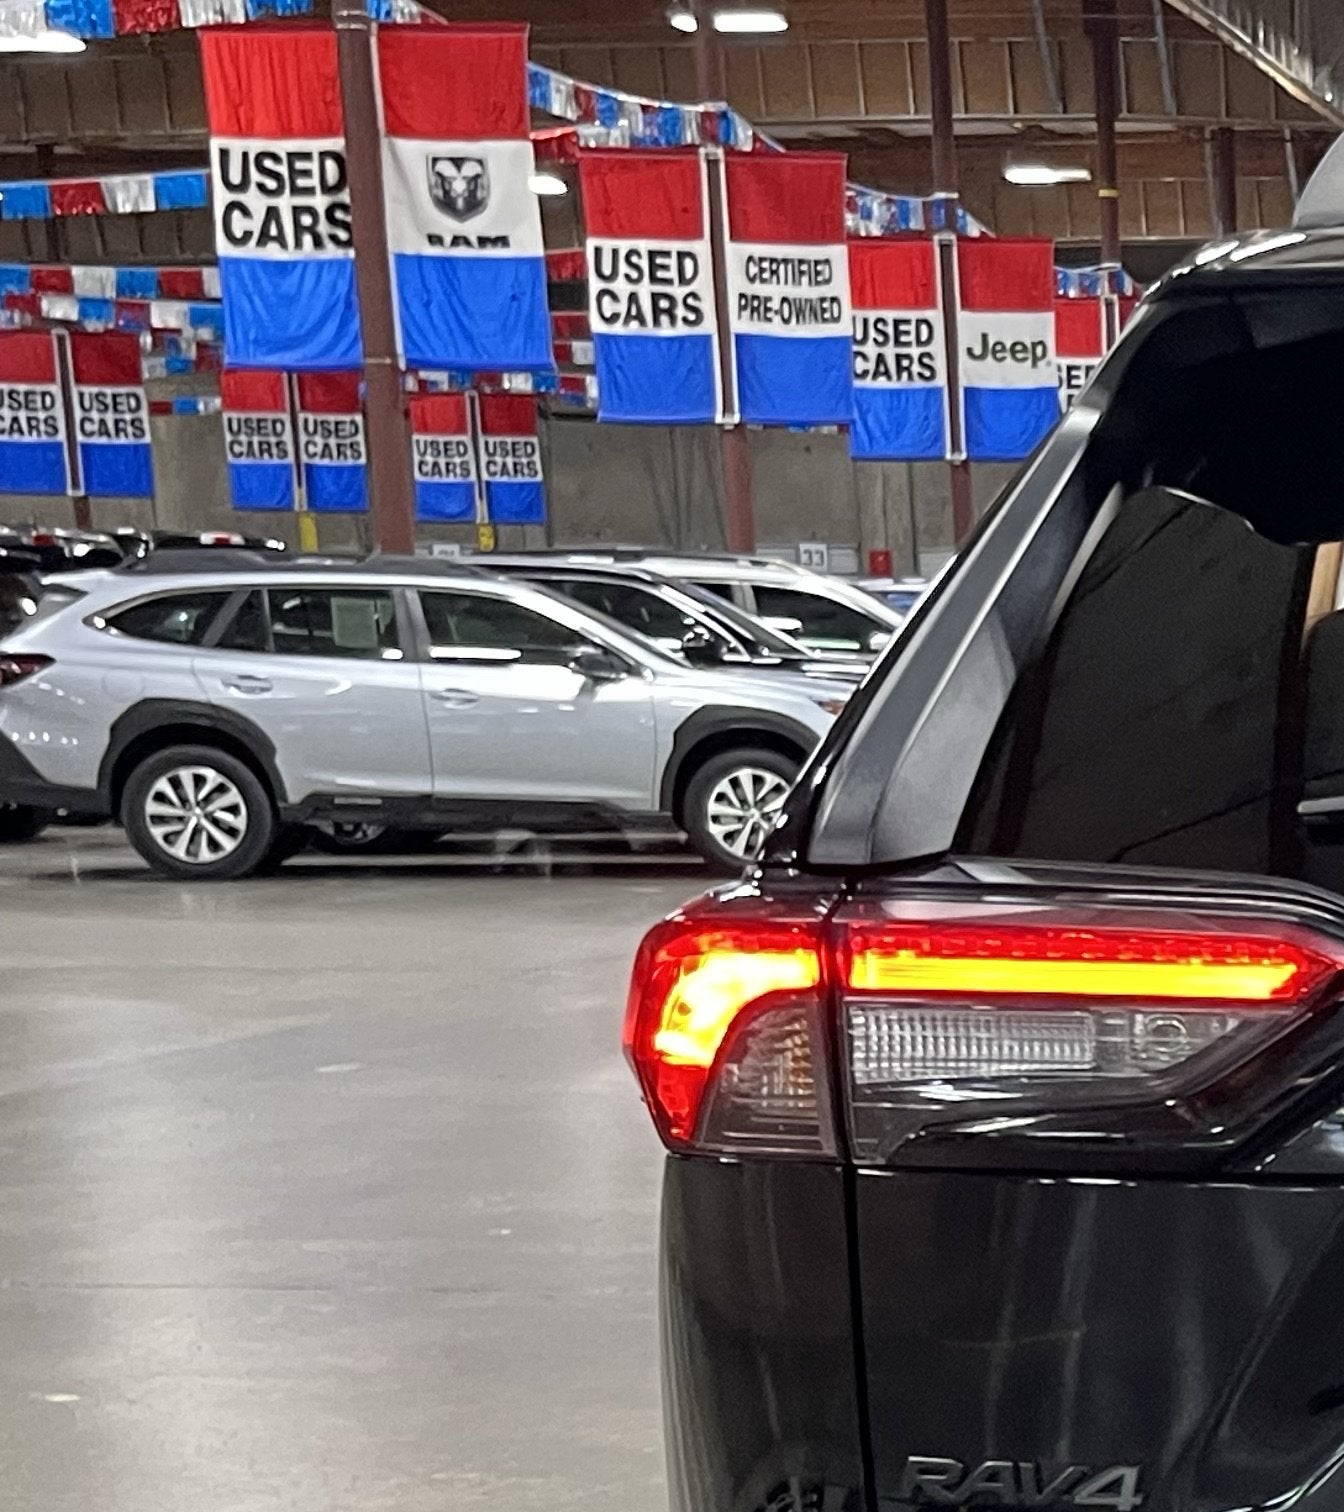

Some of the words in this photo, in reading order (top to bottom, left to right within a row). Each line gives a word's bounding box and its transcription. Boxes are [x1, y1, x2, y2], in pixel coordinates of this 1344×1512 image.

[219, 148, 347, 197] USED
[222, 200, 353, 250] CARS
[594, 246, 699, 287] USED
[745, 255, 833, 287] CERTIFIED
[596, 288, 704, 328] CARS
[737, 292, 842, 325] PRE-OWNED
[853, 316, 934, 348] USED
[966, 333, 1048, 369] Jeep
[853, 351, 937, 382] CARS
[78, 391, 142, 414] USED
[79, 416, 146, 439] CARS
[227, 417, 286, 438] USED
[303, 418, 359, 439] USED
[228, 440, 289, 459] CARS
[304, 440, 363, 461] CARS
[415, 439, 468, 459] USED
[484, 440, 536, 459] USED
[418, 460, 471, 478] CARS
[486, 460, 538, 478] CARS
[903, 1456, 1143, 1511] RAV4
